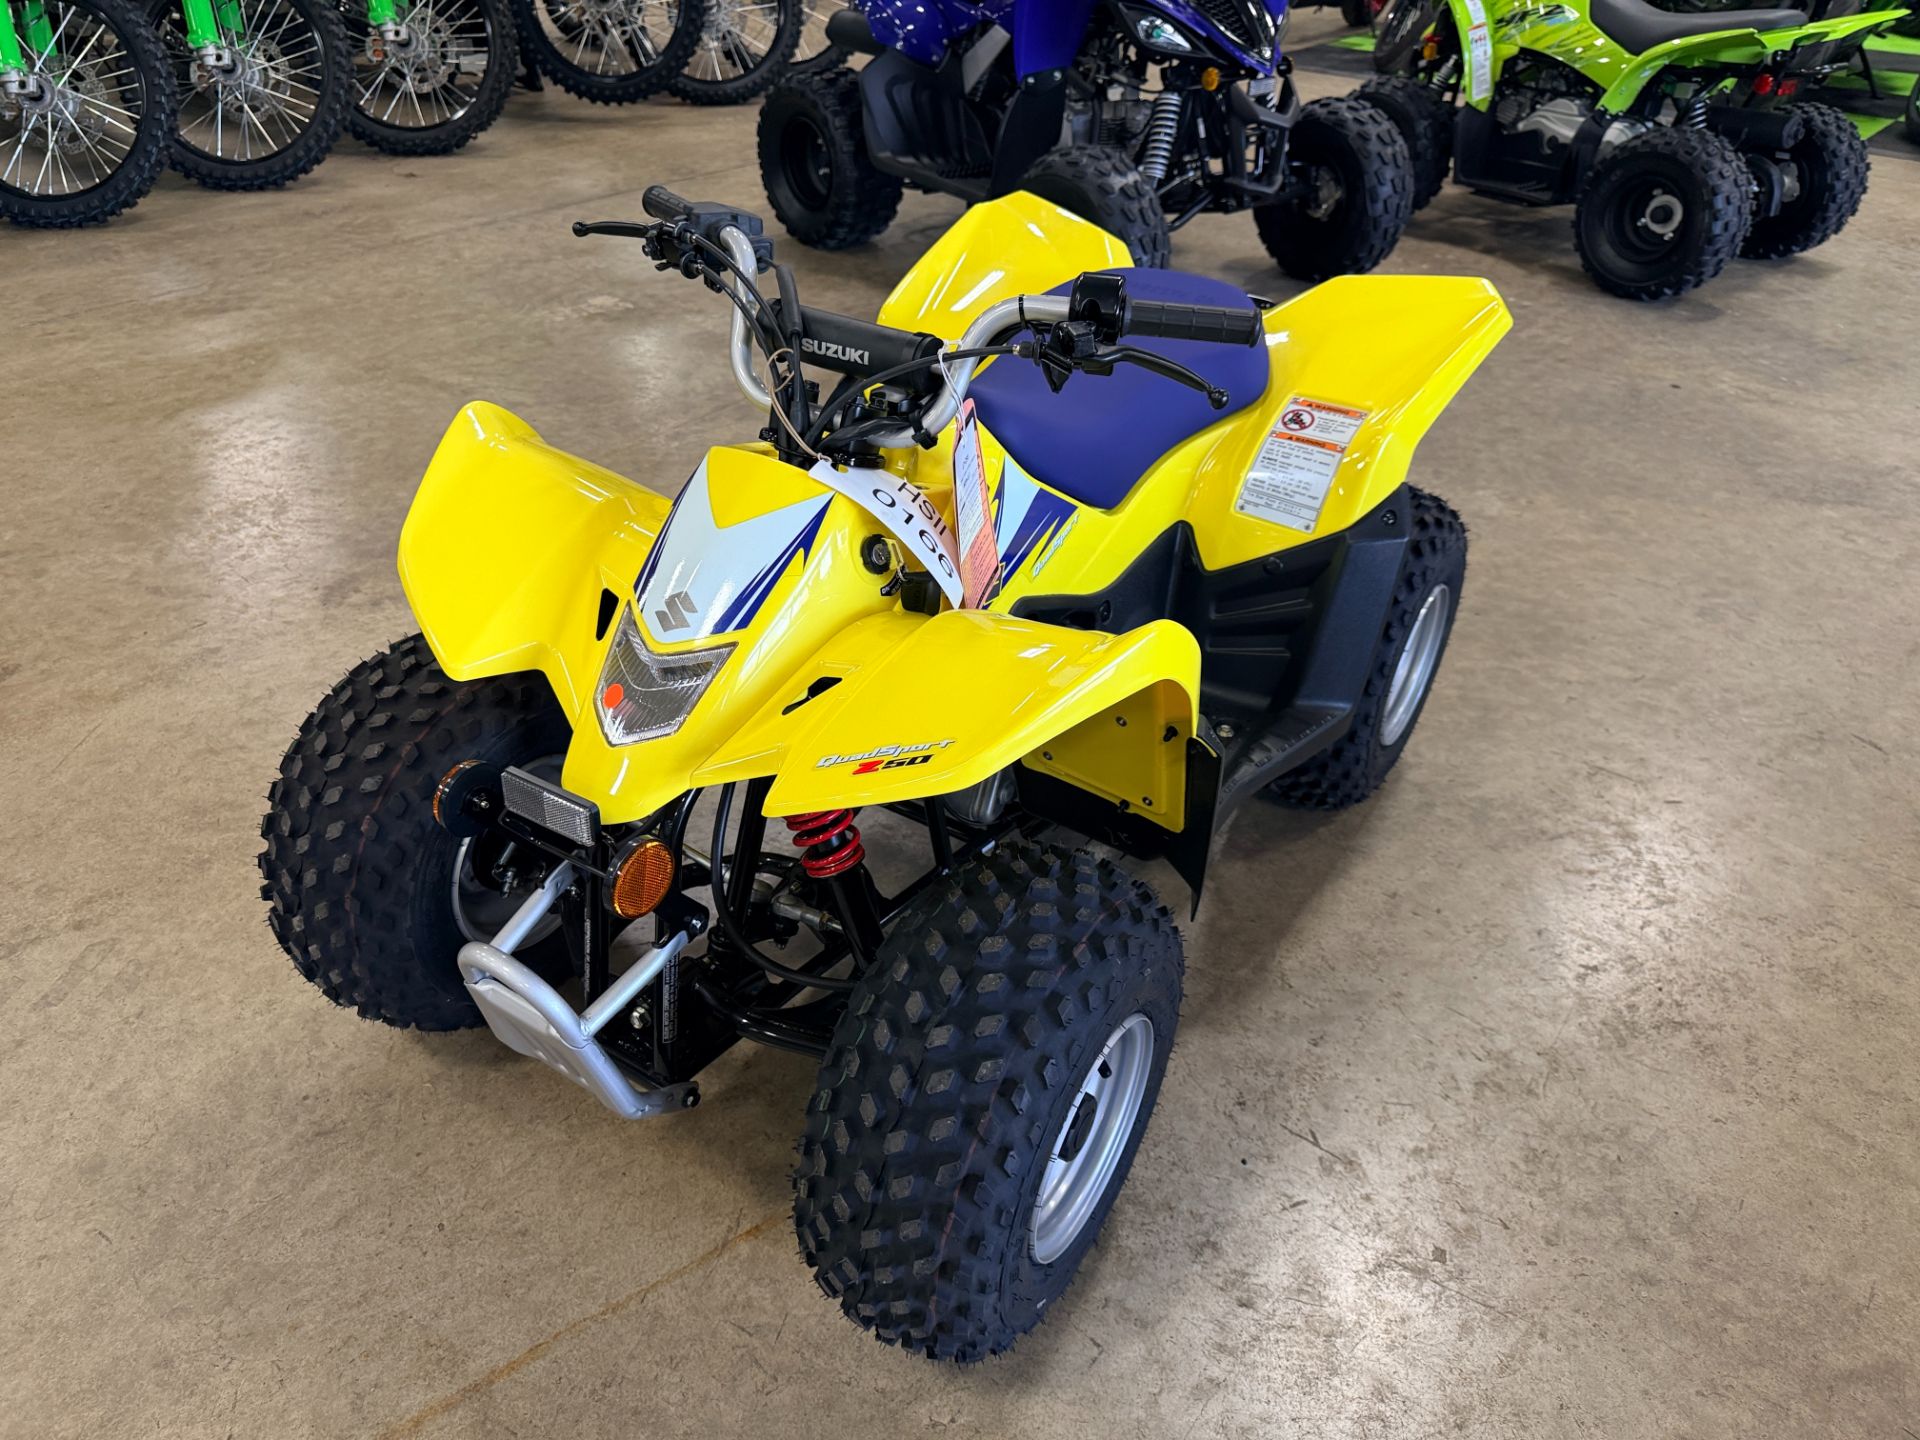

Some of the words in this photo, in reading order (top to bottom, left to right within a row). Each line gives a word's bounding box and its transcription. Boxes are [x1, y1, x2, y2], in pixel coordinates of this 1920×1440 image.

[801, 337, 870, 366] SUZUKI
[872, 488, 954, 578] 0166
[815, 738, 956, 768] QuadSport
